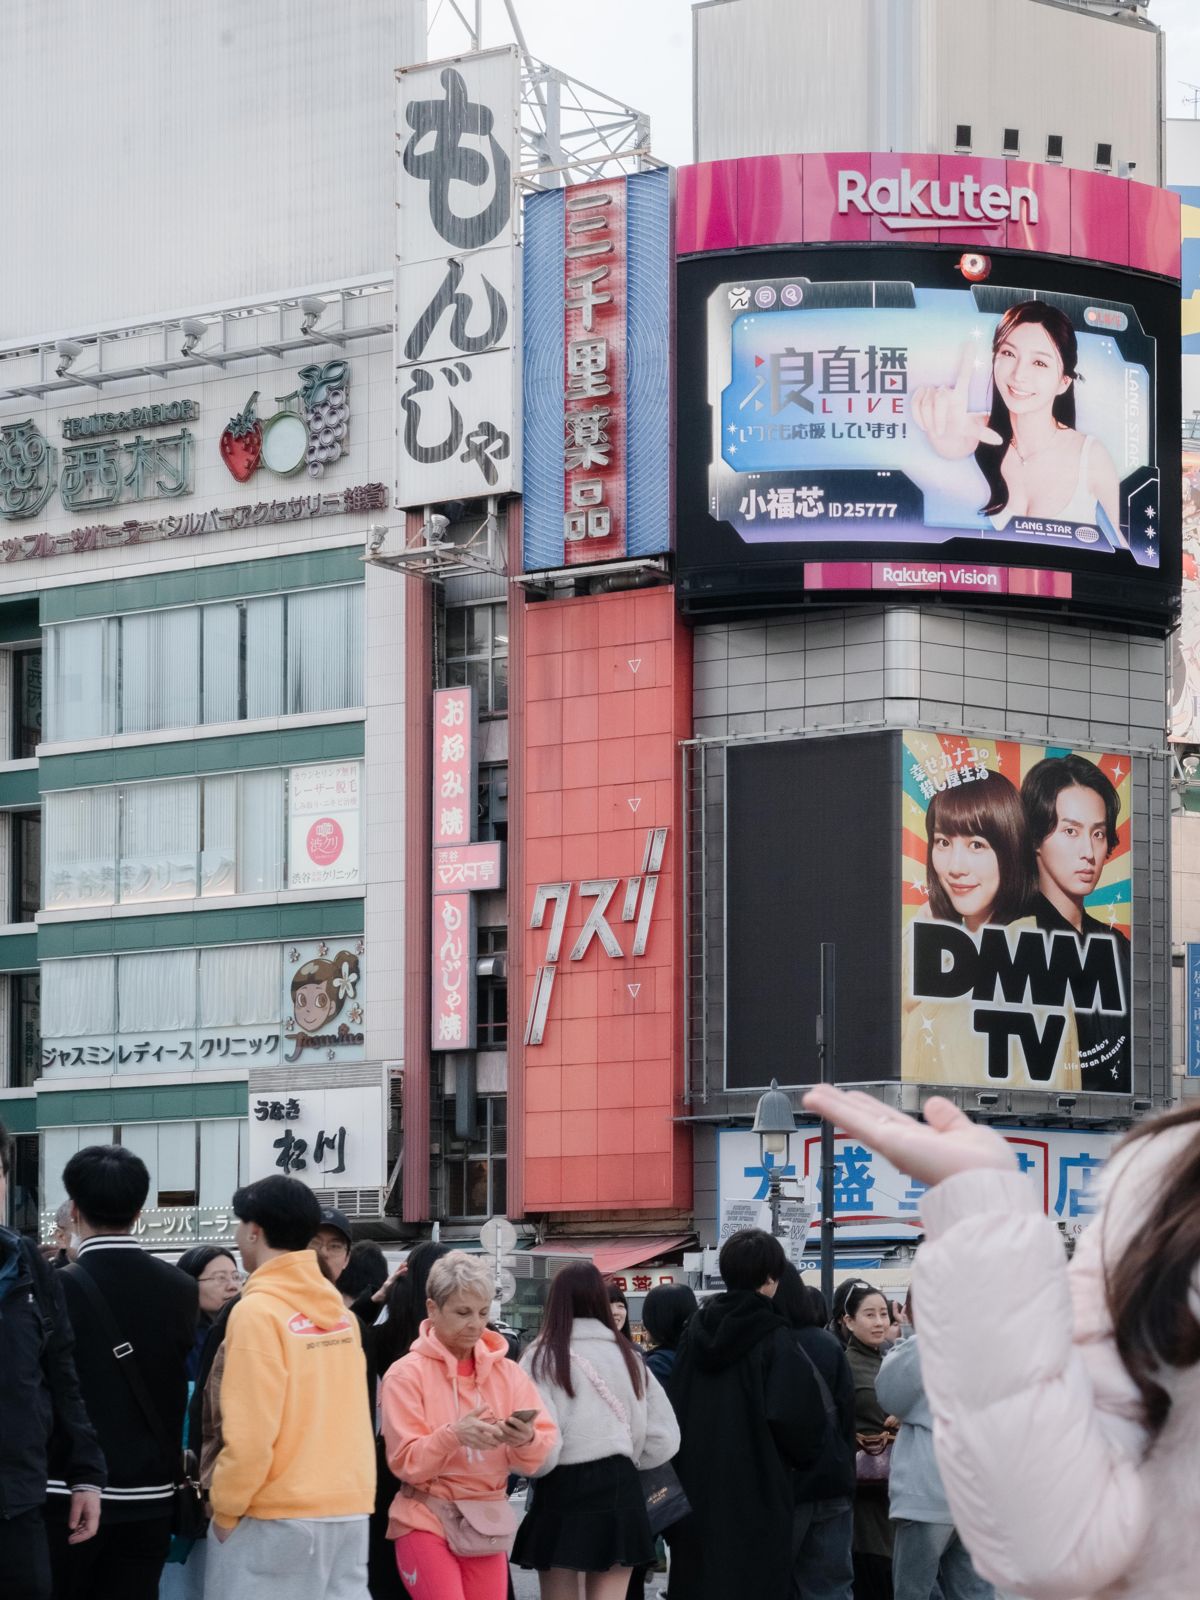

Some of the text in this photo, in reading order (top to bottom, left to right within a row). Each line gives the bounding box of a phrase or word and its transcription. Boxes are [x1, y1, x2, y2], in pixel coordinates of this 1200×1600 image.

[837, 169, 1039, 230] Rakuten
[403, 67, 511, 486] もんじゃ
[565, 192, 612, 541] 三千里薬品
[821, 397, 904, 414] LIVE
[61, 428, 194, 513] 西村
[738, 486, 898, 521] 小福芯 ID 25777
[1015, 520, 1072, 535] LANG STAR
[882, 567, 997, 586] Rakuten Vision
[441, 698, 465, 836] お好み焼
[910, 747, 989, 782] 幸せカナコの
[438, 850, 459, 863] 渋谷
[439, 901, 462, 1041] もんじゃ焼
[911, 921, 1124, 1013] DMM
[972, 1008, 1067, 1082] TV
[1077, 1039, 1109, 1058] Kanako's
[1100, 1035, 1126, 1063] Assassin
[273, 1126, 347, 1175] 松川
